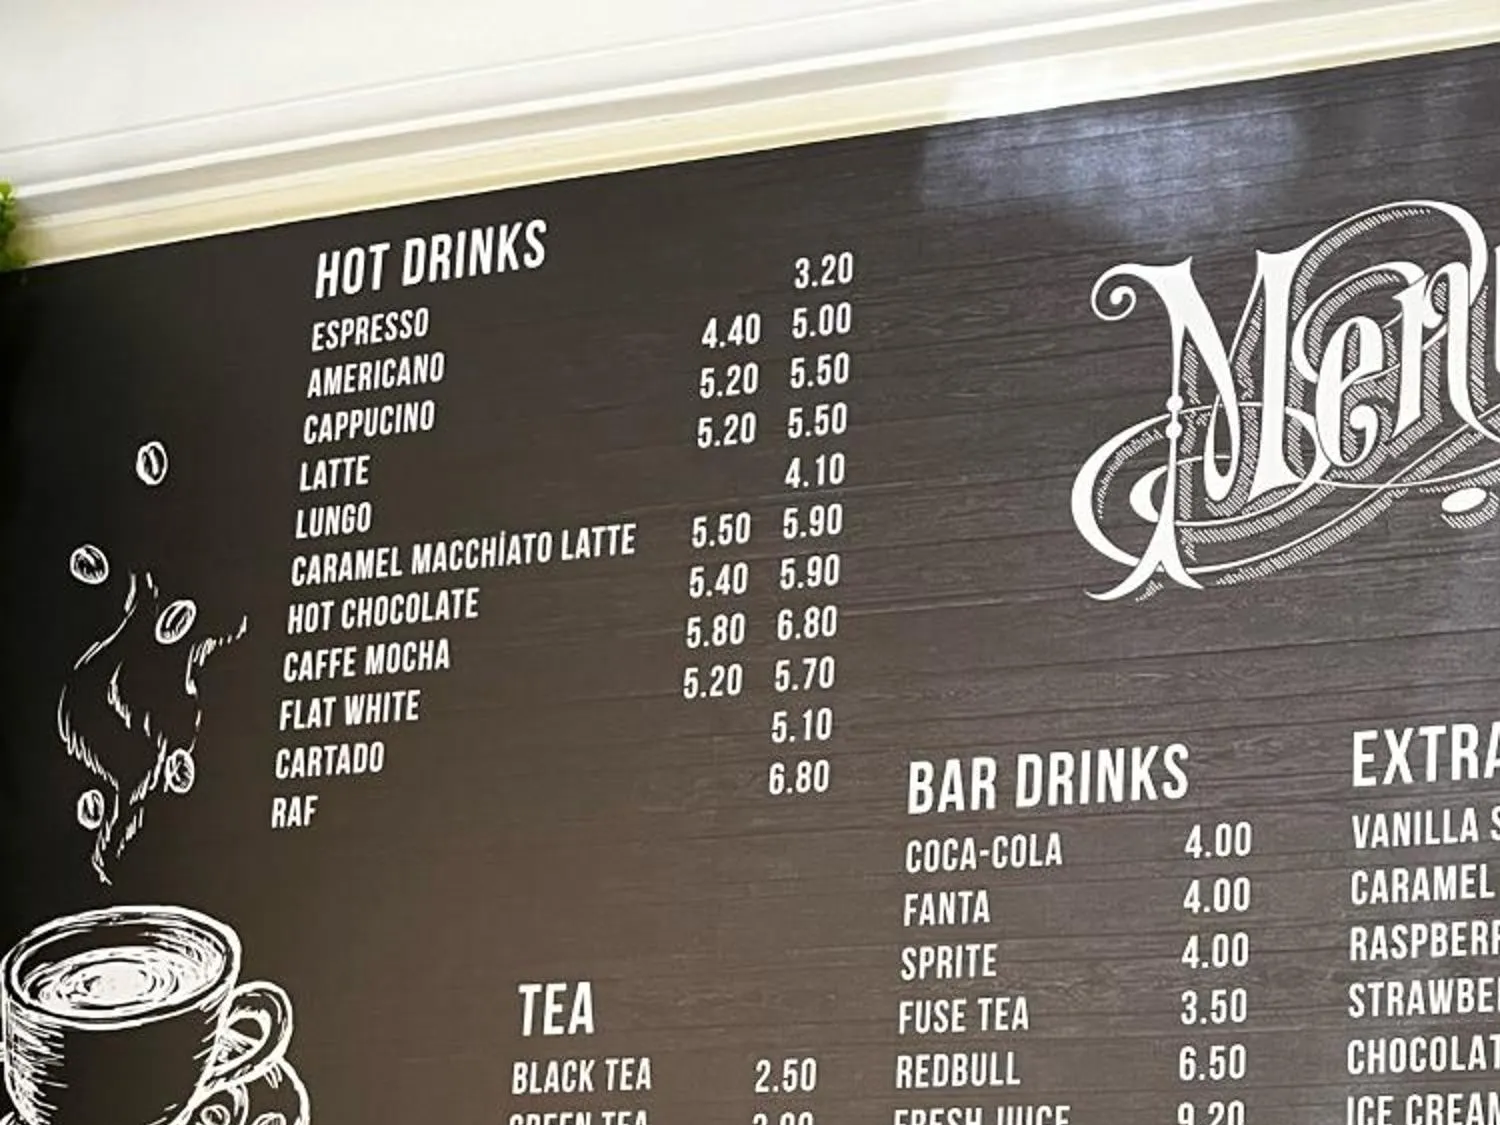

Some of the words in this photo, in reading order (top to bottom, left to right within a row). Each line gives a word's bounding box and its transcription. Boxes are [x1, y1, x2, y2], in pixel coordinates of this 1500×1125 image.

[315, 242, 391, 300] HOT
[401, 219, 547, 287] DRINKS
[794, 251, 854, 289] 3.20
[311, 307, 429, 353] ESPRESSO
[701, 312, 761, 349] 4.40
[791, 301, 852, 339] 5.00
[306, 351, 445, 399] AMERICANO
[699, 361, 759, 399] 5.20
[790, 351, 850, 389] 5.50
[303, 399, 435, 445] CAPPUCINO
[697, 411, 757, 449] 5.20
[787, 401, 848, 439] 5.50
[299, 454, 371, 492] LATTE
[784, 452, 845, 489] 4.10
[295, 501, 372, 540] LUNGO
[691, 511, 751, 549] 5.50
[782, 503, 843, 540] 5.90
[291, 546, 403, 587] CARAMEL
[561, 523, 637, 561] LATTE
[689, 561, 749, 599] 5.40
[779, 553, 841, 591] 5.90
[287, 599, 335, 635] HOT
[341, 587, 480, 630] CHOCOLATE
[686, 612, 746, 649] 5.80
[777, 605, 838, 641] 6.80
[283, 645, 357, 683] CAFFE
[364, 638, 450, 676] MOCHA
[683, 663, 743, 699] 5.20
[774, 655, 835, 693] 5.70
[279, 695, 337, 731] FLAT
[344, 689, 421, 726] WHITE
[771, 707, 833, 744] 5.10
[275, 741, 385, 780] CARTADO
[769, 759, 830, 795] 6.80
[907, 756, 997, 815] BAR
[1015, 743, 1189, 808] DRINKS
[271, 794, 319, 829] RAF
[1351, 807, 1479, 849] VANILLA
[905, 832, 1063, 874] COCA-COLA
[1184, 821, 1252, 859] 4.00
[1183, 877, 1251, 914] 4.00
[1351, 863, 1495, 906] CARAMEL
[903, 889, 990, 927] FANTA
[900, 943, 998, 981] SPRITE
[1181, 931, 1249, 969] 4.00
[518, 981, 595, 1037] TEA
[899, 998, 967, 1035] FUSE
[977, 996, 1029, 1031] TEA
[1180, 987, 1247, 1025] 3.50
[511, 1059, 596, 1095] BLACK
[605, 1057, 652, 1091] TEA
[754, 1057, 817, 1093] 2.50
[895, 1051, 1021, 1089] REDBULL
[1179, 1043, 1246, 1081] 6.50
